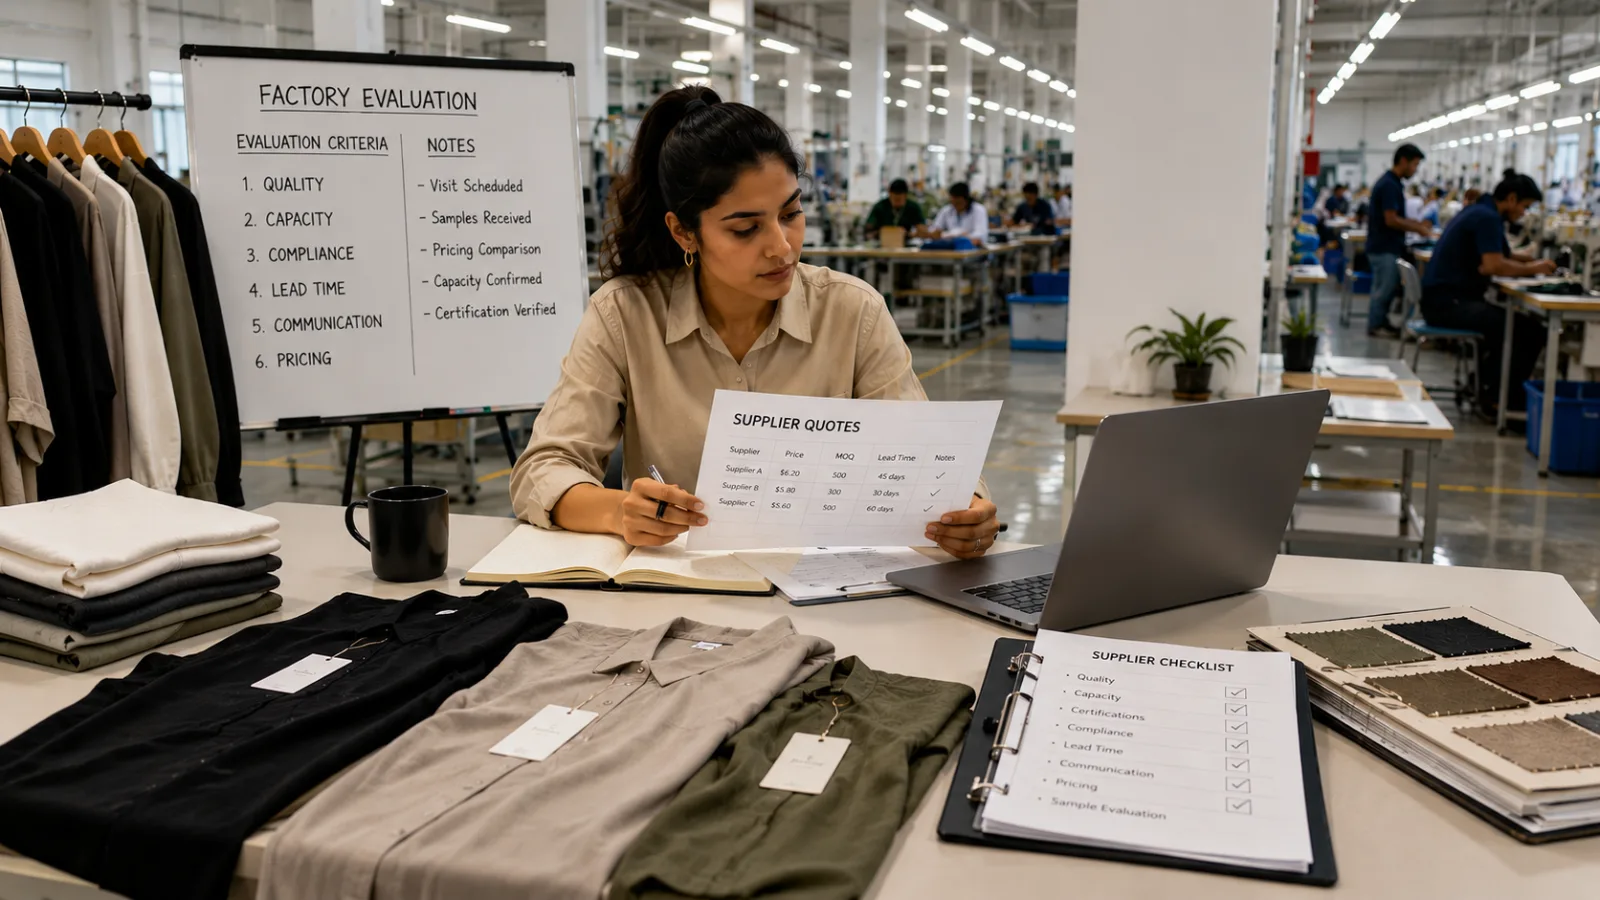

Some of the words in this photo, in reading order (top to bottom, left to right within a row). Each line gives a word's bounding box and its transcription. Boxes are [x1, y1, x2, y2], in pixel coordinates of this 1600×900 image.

[260, 83, 350, 108] FACTORY
[363, 87, 476, 111] EVALUATION
[237, 133, 320, 150] EVALUATION
[328, 135, 388, 151] CRITERIA
[428, 137, 475, 154] NOTES
[243, 176, 252, 192] 1.
[264, 176, 323, 193] QUALITY
[430, 178, 458, 193] Visit
[245, 212, 256, 228] 2.
[266, 211, 333, 227] CAPACITY
[432, 210, 478, 229] Samples
[484, 209, 531, 225] Received
[247, 247, 259, 263] 3.
[269, 245, 354, 263] COMPLIANCE
[433, 242, 473, 261] Pricing
[479, 241, 541, 256] Comparison
[249, 282, 262, 298] 4.
[272, 281, 307, 298] LEAD
[313, 280, 345, 296] TIME
[434, 273, 481, 292] Capacity
[487, 271, 542, 287] Confirmed
[435, 304, 509, 320] Certification
[514, 301, 556, 317] Verified
[253, 317, 265, 334] 5.
[274, 314, 382, 333] COMMUNICATION
[255, 353, 267, 369] 6.
[277, 350, 331, 368] PRICING
[732, 412, 801, 431] SUPPLIER
[804, 418, 861, 433] QUOTES
[729, 445, 761, 456] Supplier
[784, 449, 805, 459] Price
[834, 452, 855, 461] MOQ
[877, 454, 897, 462] Lead
[897, 454, 917, 462] Time
[934, 454, 956, 462] Notes
[725, 464, 756, 474] Supplier
[756, 467, 763, 475] A
[779, 468, 801, 477] $6.20
[831, 471, 847, 479] 500
[877, 472, 887, 480] 45
[889, 473, 906, 482] days
[721, 481, 753, 492] Supplier
[753, 484, 760, 492] B
[827, 488, 842, 496] 300
[872, 489, 882, 497] 30
[883, 489, 900, 498] days
[718, 497, 749, 507] Supplier
[770, 501, 792, 510] $5.60
[822, 503, 837, 511] 500
[877, 505, 894, 514] days
[1091, 650, 1156, 666] SUPPLIER
[1159, 657, 1235, 673] CHECKLIST
[1077, 673, 1116, 686] Quality
[1074, 689, 1122, 703] Capacity
[1070, 706, 1146, 721] Certifications
[1067, 723, 1134, 738] Compliance
[1063, 740, 1093, 752] Lead
[1095, 744, 1124, 755] Time
[1059, 759, 1155, 779] Communication
[1055, 777, 1099, 793] Pricing
[1051, 796, 1098, 811] Sample
[1100, 803, 1167, 820] Evaluation
